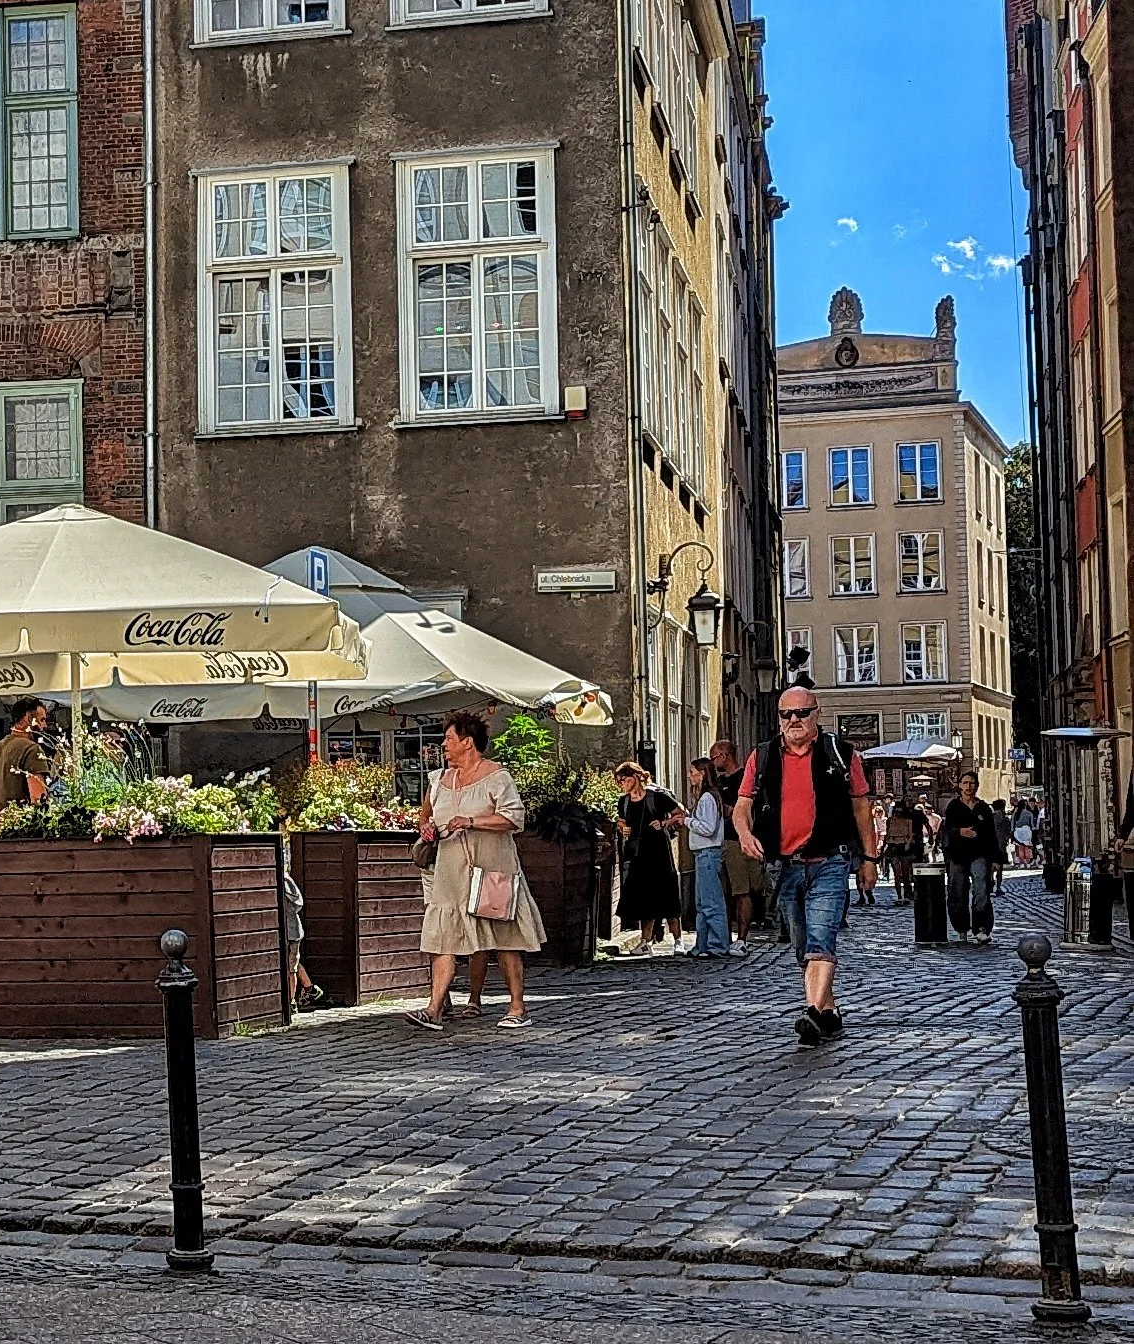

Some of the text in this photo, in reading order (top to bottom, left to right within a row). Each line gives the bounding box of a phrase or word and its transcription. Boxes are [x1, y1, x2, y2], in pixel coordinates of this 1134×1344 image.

[313, 557, 326, 591] P
[124, 612, 233, 646] Coca-Cola
[149, 698, 208, 718] Coca-Cola
